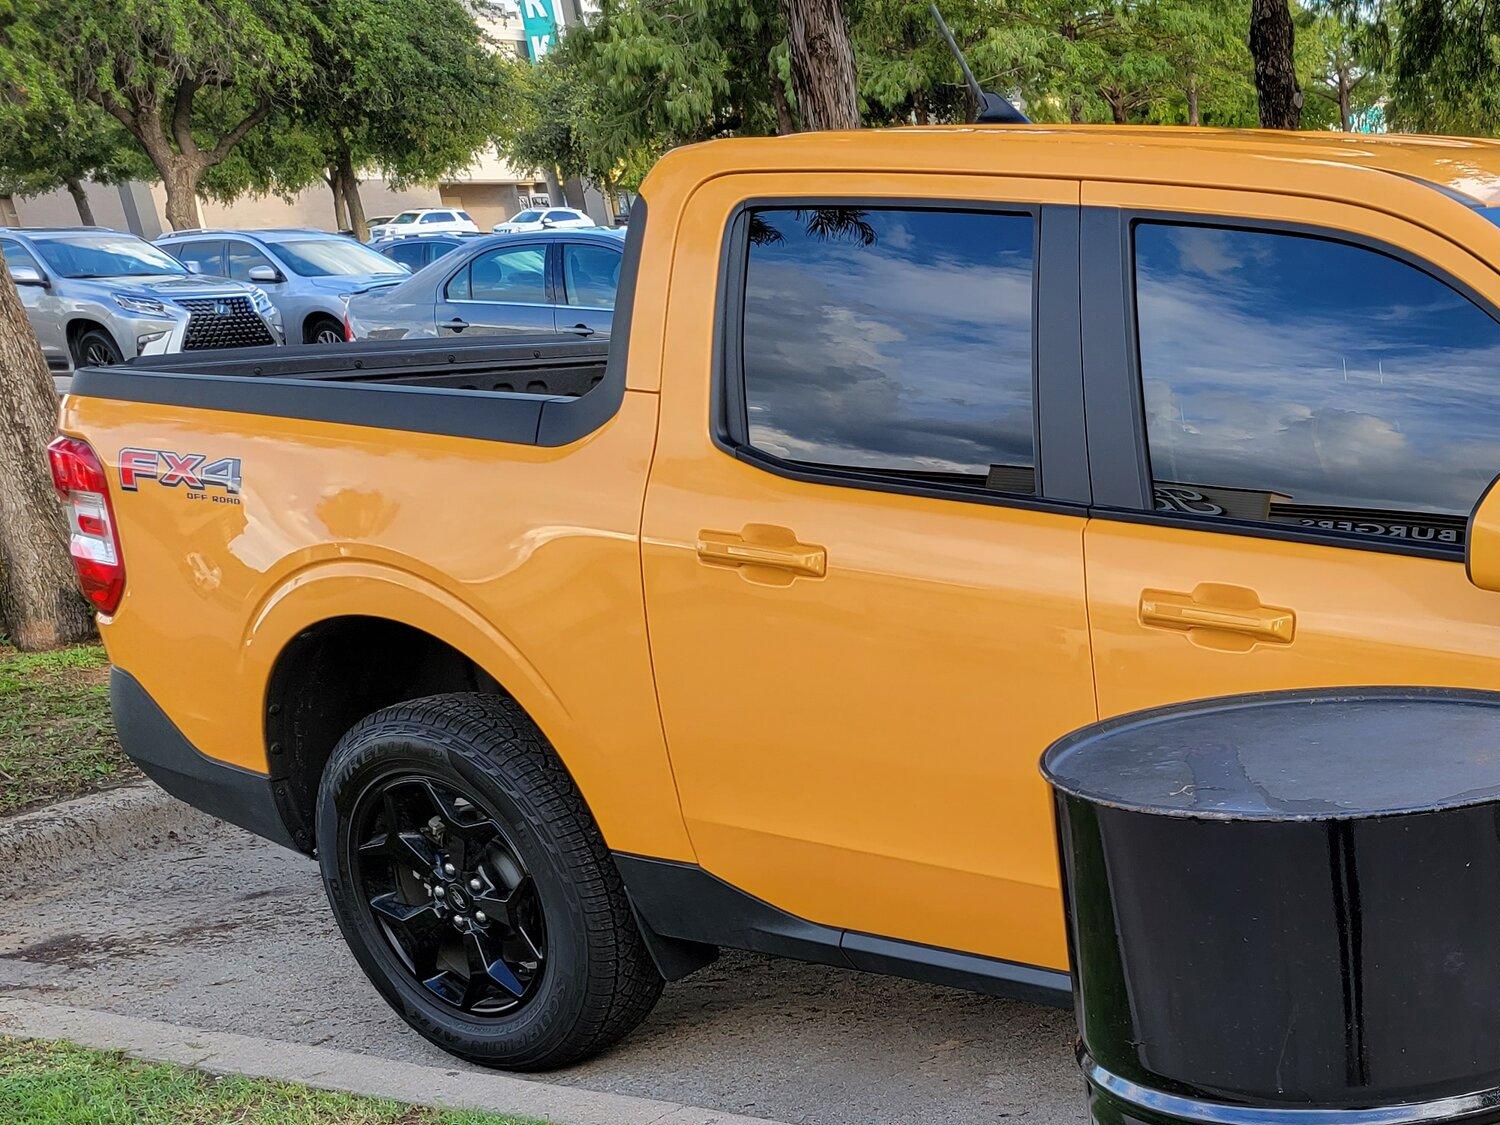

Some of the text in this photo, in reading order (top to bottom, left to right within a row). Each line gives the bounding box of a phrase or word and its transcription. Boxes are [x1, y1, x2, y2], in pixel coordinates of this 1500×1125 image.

[119, 447, 241, 494] FX4
[186, 492, 241, 505] OFF ROAD
